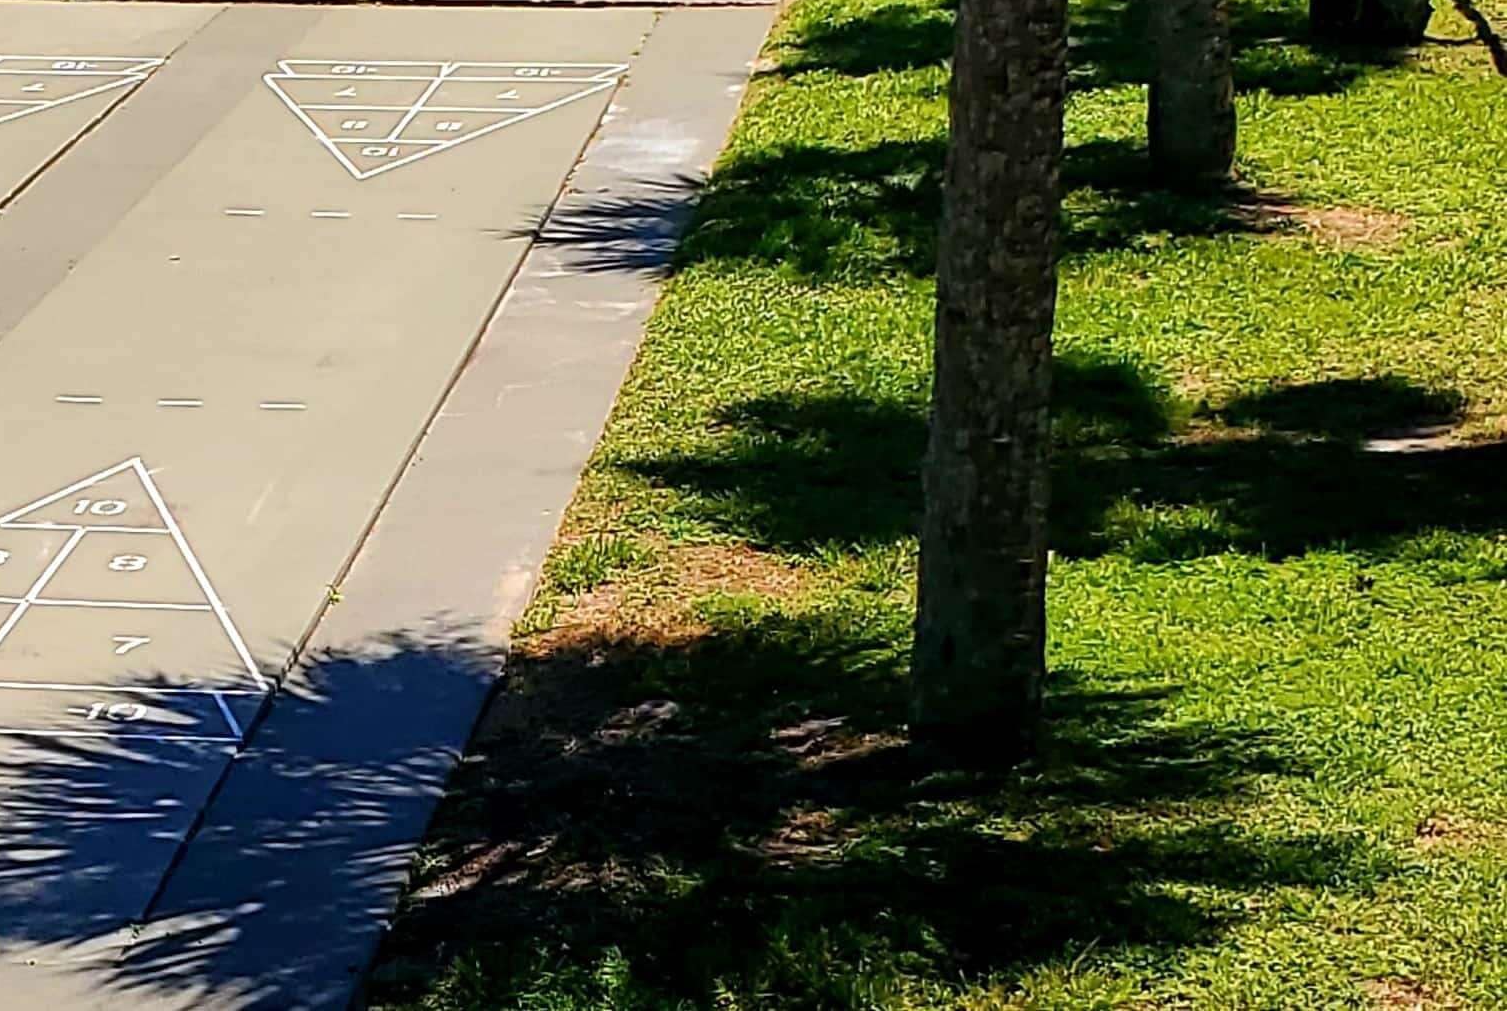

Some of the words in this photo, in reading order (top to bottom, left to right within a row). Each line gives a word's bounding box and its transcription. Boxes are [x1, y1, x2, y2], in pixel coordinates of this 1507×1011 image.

[73, 499, 127, 515] 10
[108, 555, 148, 571] 8
[112, 636, 151, 654] 7
